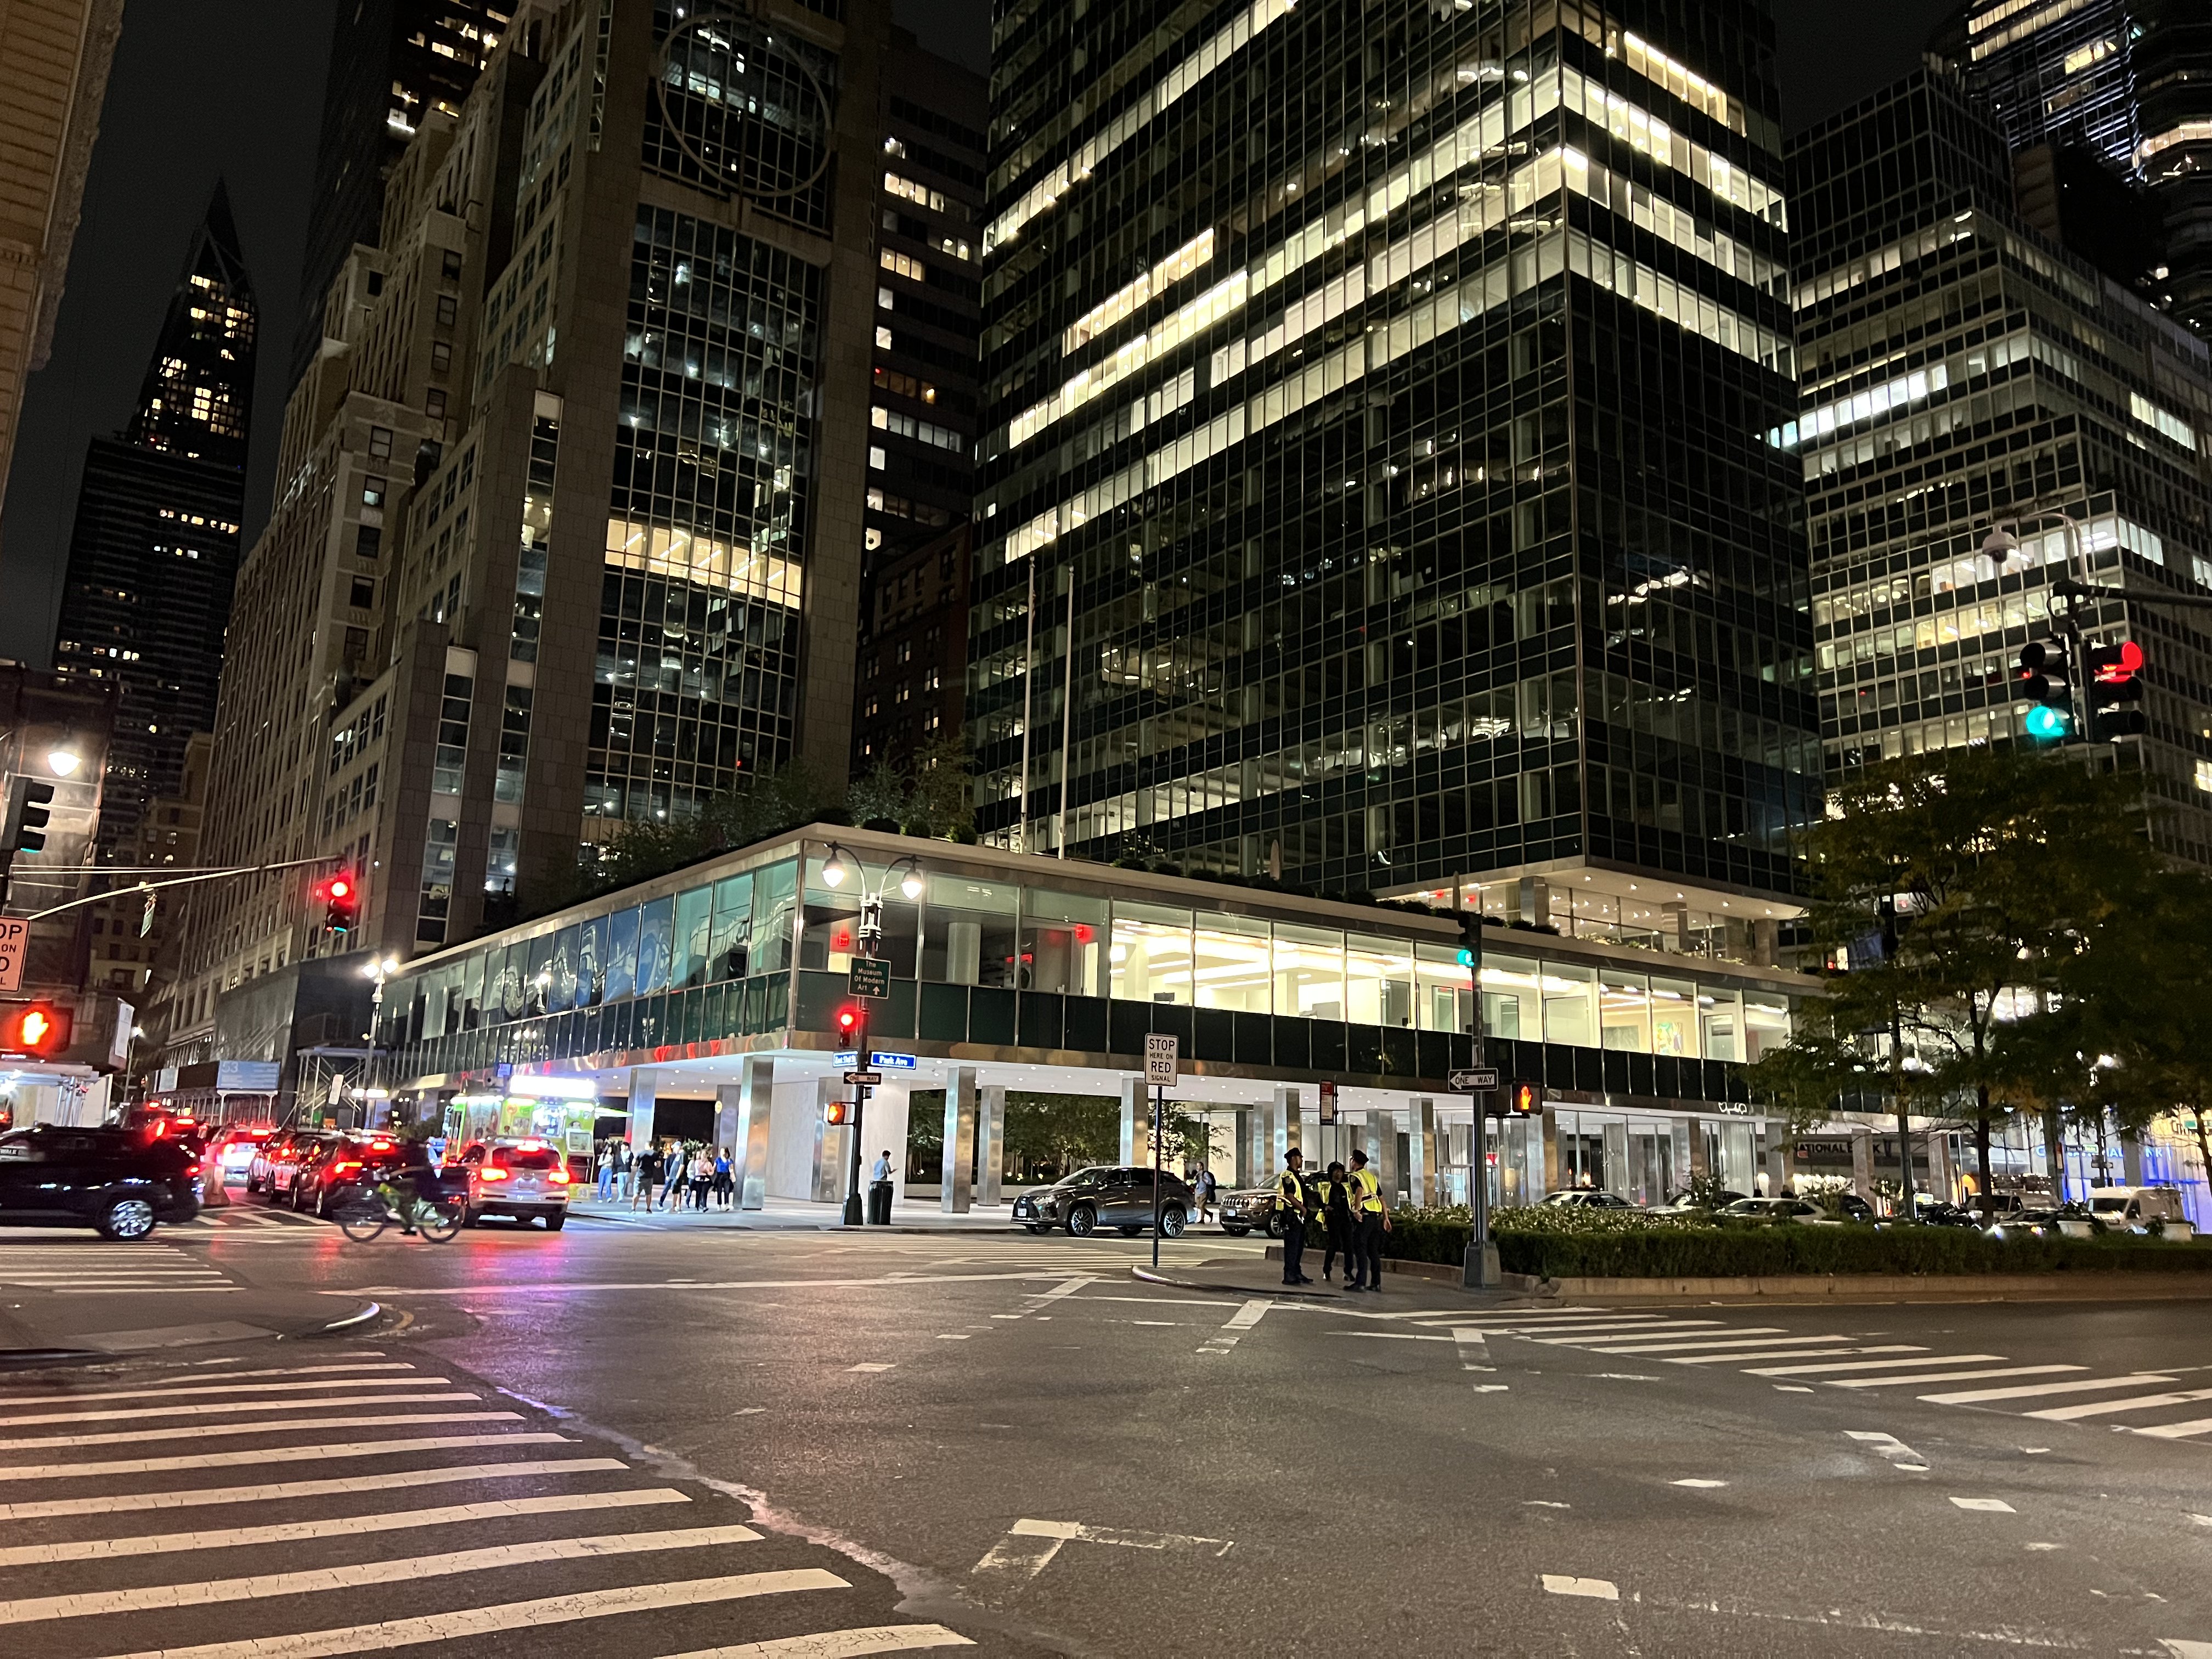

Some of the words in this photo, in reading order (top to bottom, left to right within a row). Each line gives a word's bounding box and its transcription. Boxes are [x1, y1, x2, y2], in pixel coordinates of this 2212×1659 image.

[1, 944, 16, 953] ON
[857, 967, 882, 977] Museum
[862, 977, 885, 985] Modern
[1149, 1038, 1175, 1051] STOP
[879, 1055, 895, 1064] Park
[1151, 1061, 1171, 1073] RED
[1455, 1076, 1470, 1085] ONE
[1477, 1075, 1493, 1084] WAY
